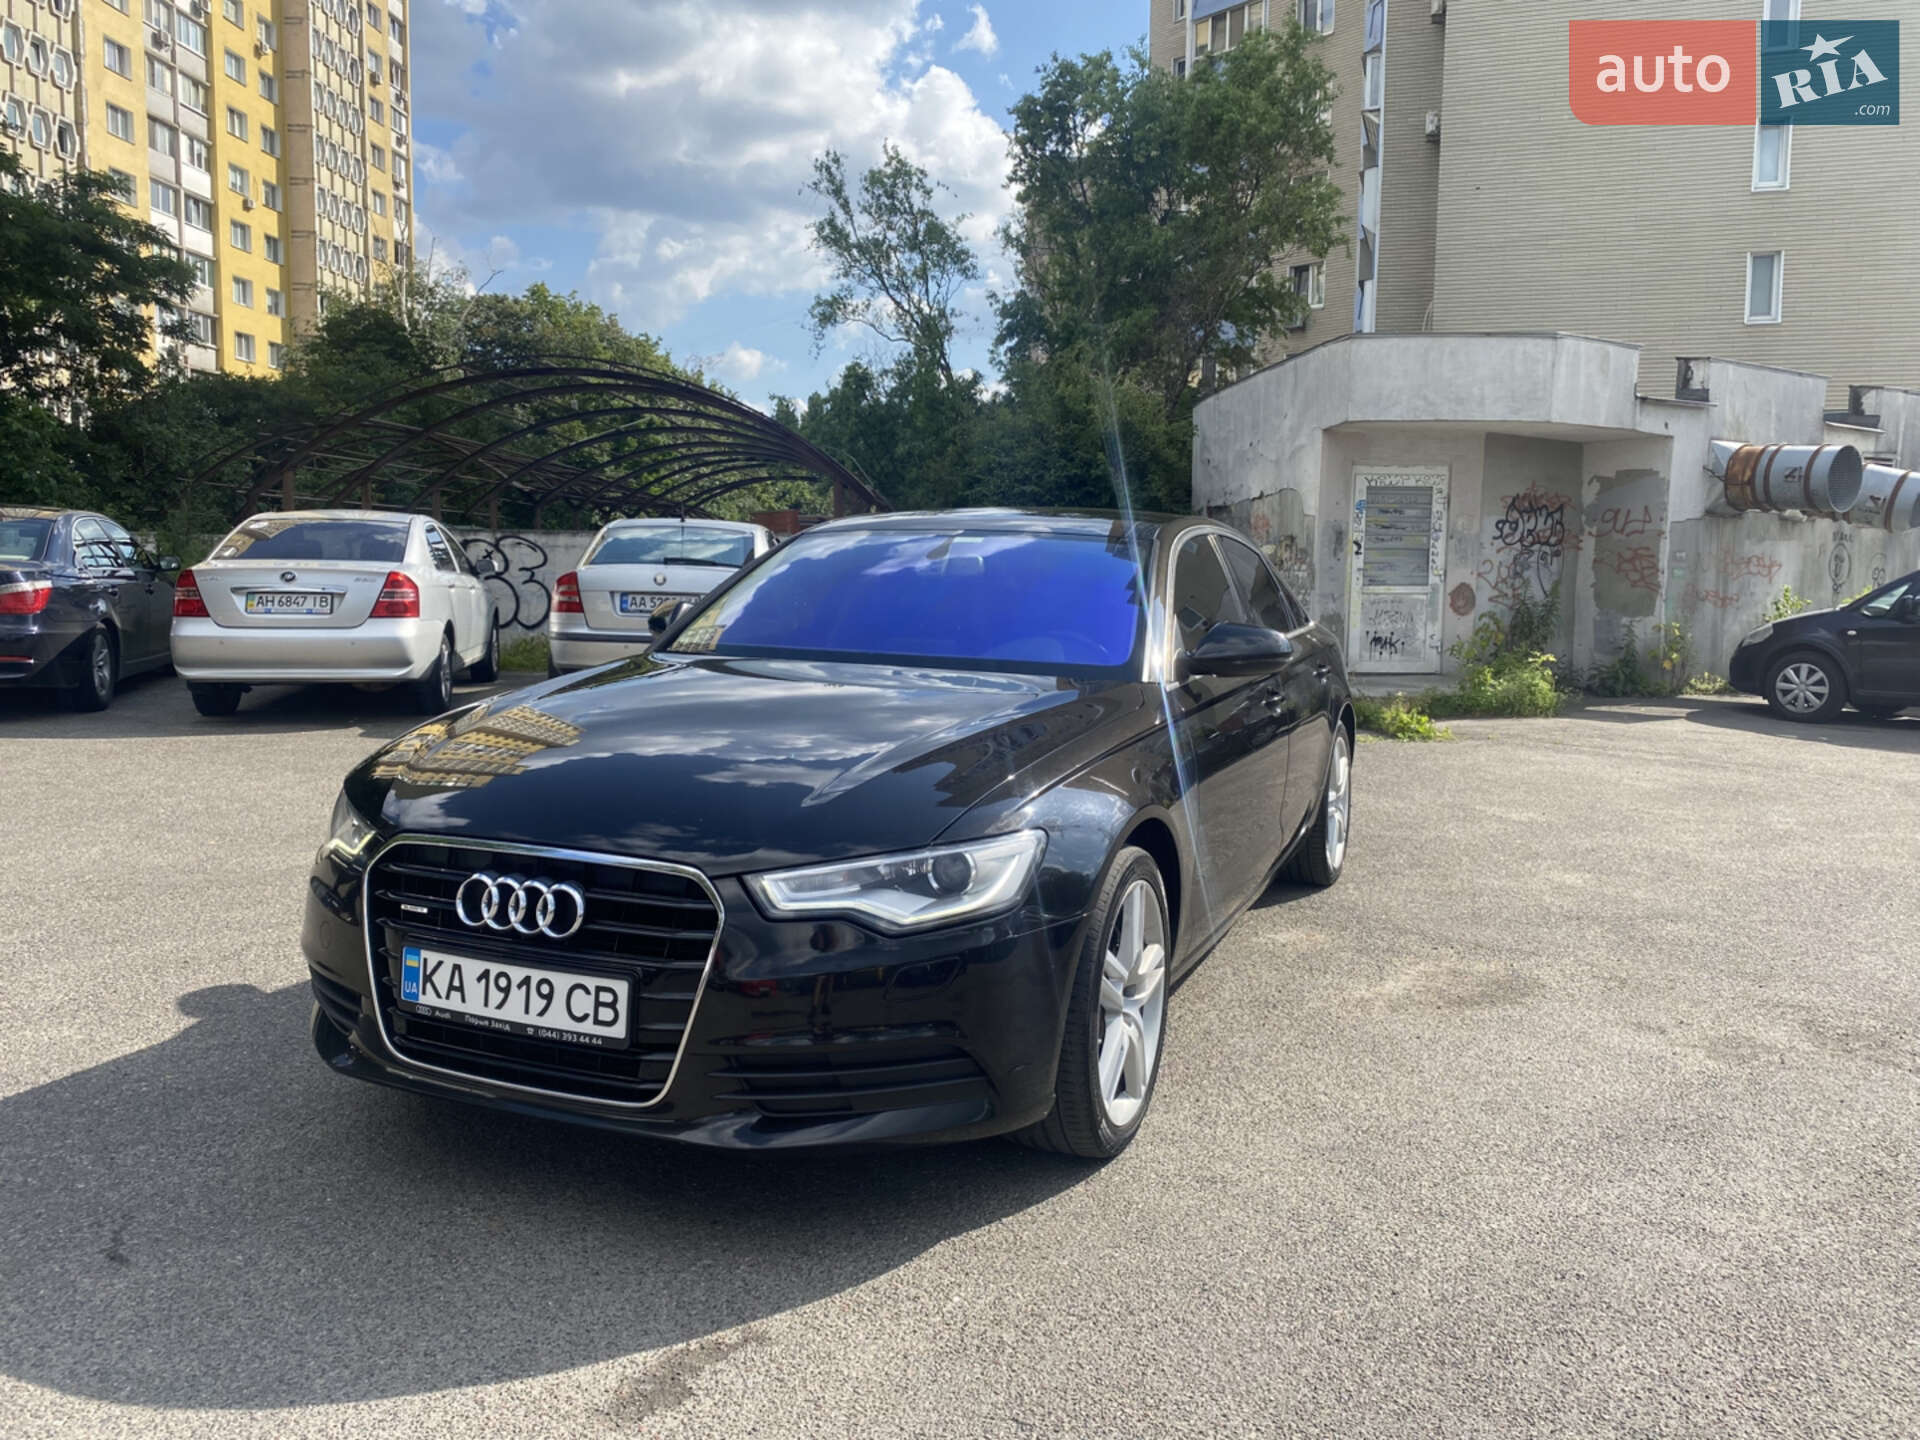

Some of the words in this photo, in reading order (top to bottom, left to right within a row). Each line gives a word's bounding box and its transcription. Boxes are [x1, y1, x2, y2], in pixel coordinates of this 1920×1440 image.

[256, 596, 275, 608] AH
[277, 596, 307, 608] 6847
[630, 596, 647, 609] AA
[404, 981, 418, 994] UA
[421, 957, 466, 1004] KA
[475, 968, 555, 1018] 1919
[565, 983, 620, 1028] CB
[538, 1028, 560, 1041] (044)
[579, 1035, 590, 1044] 44
[591, 1037, 603, 1046] 44
